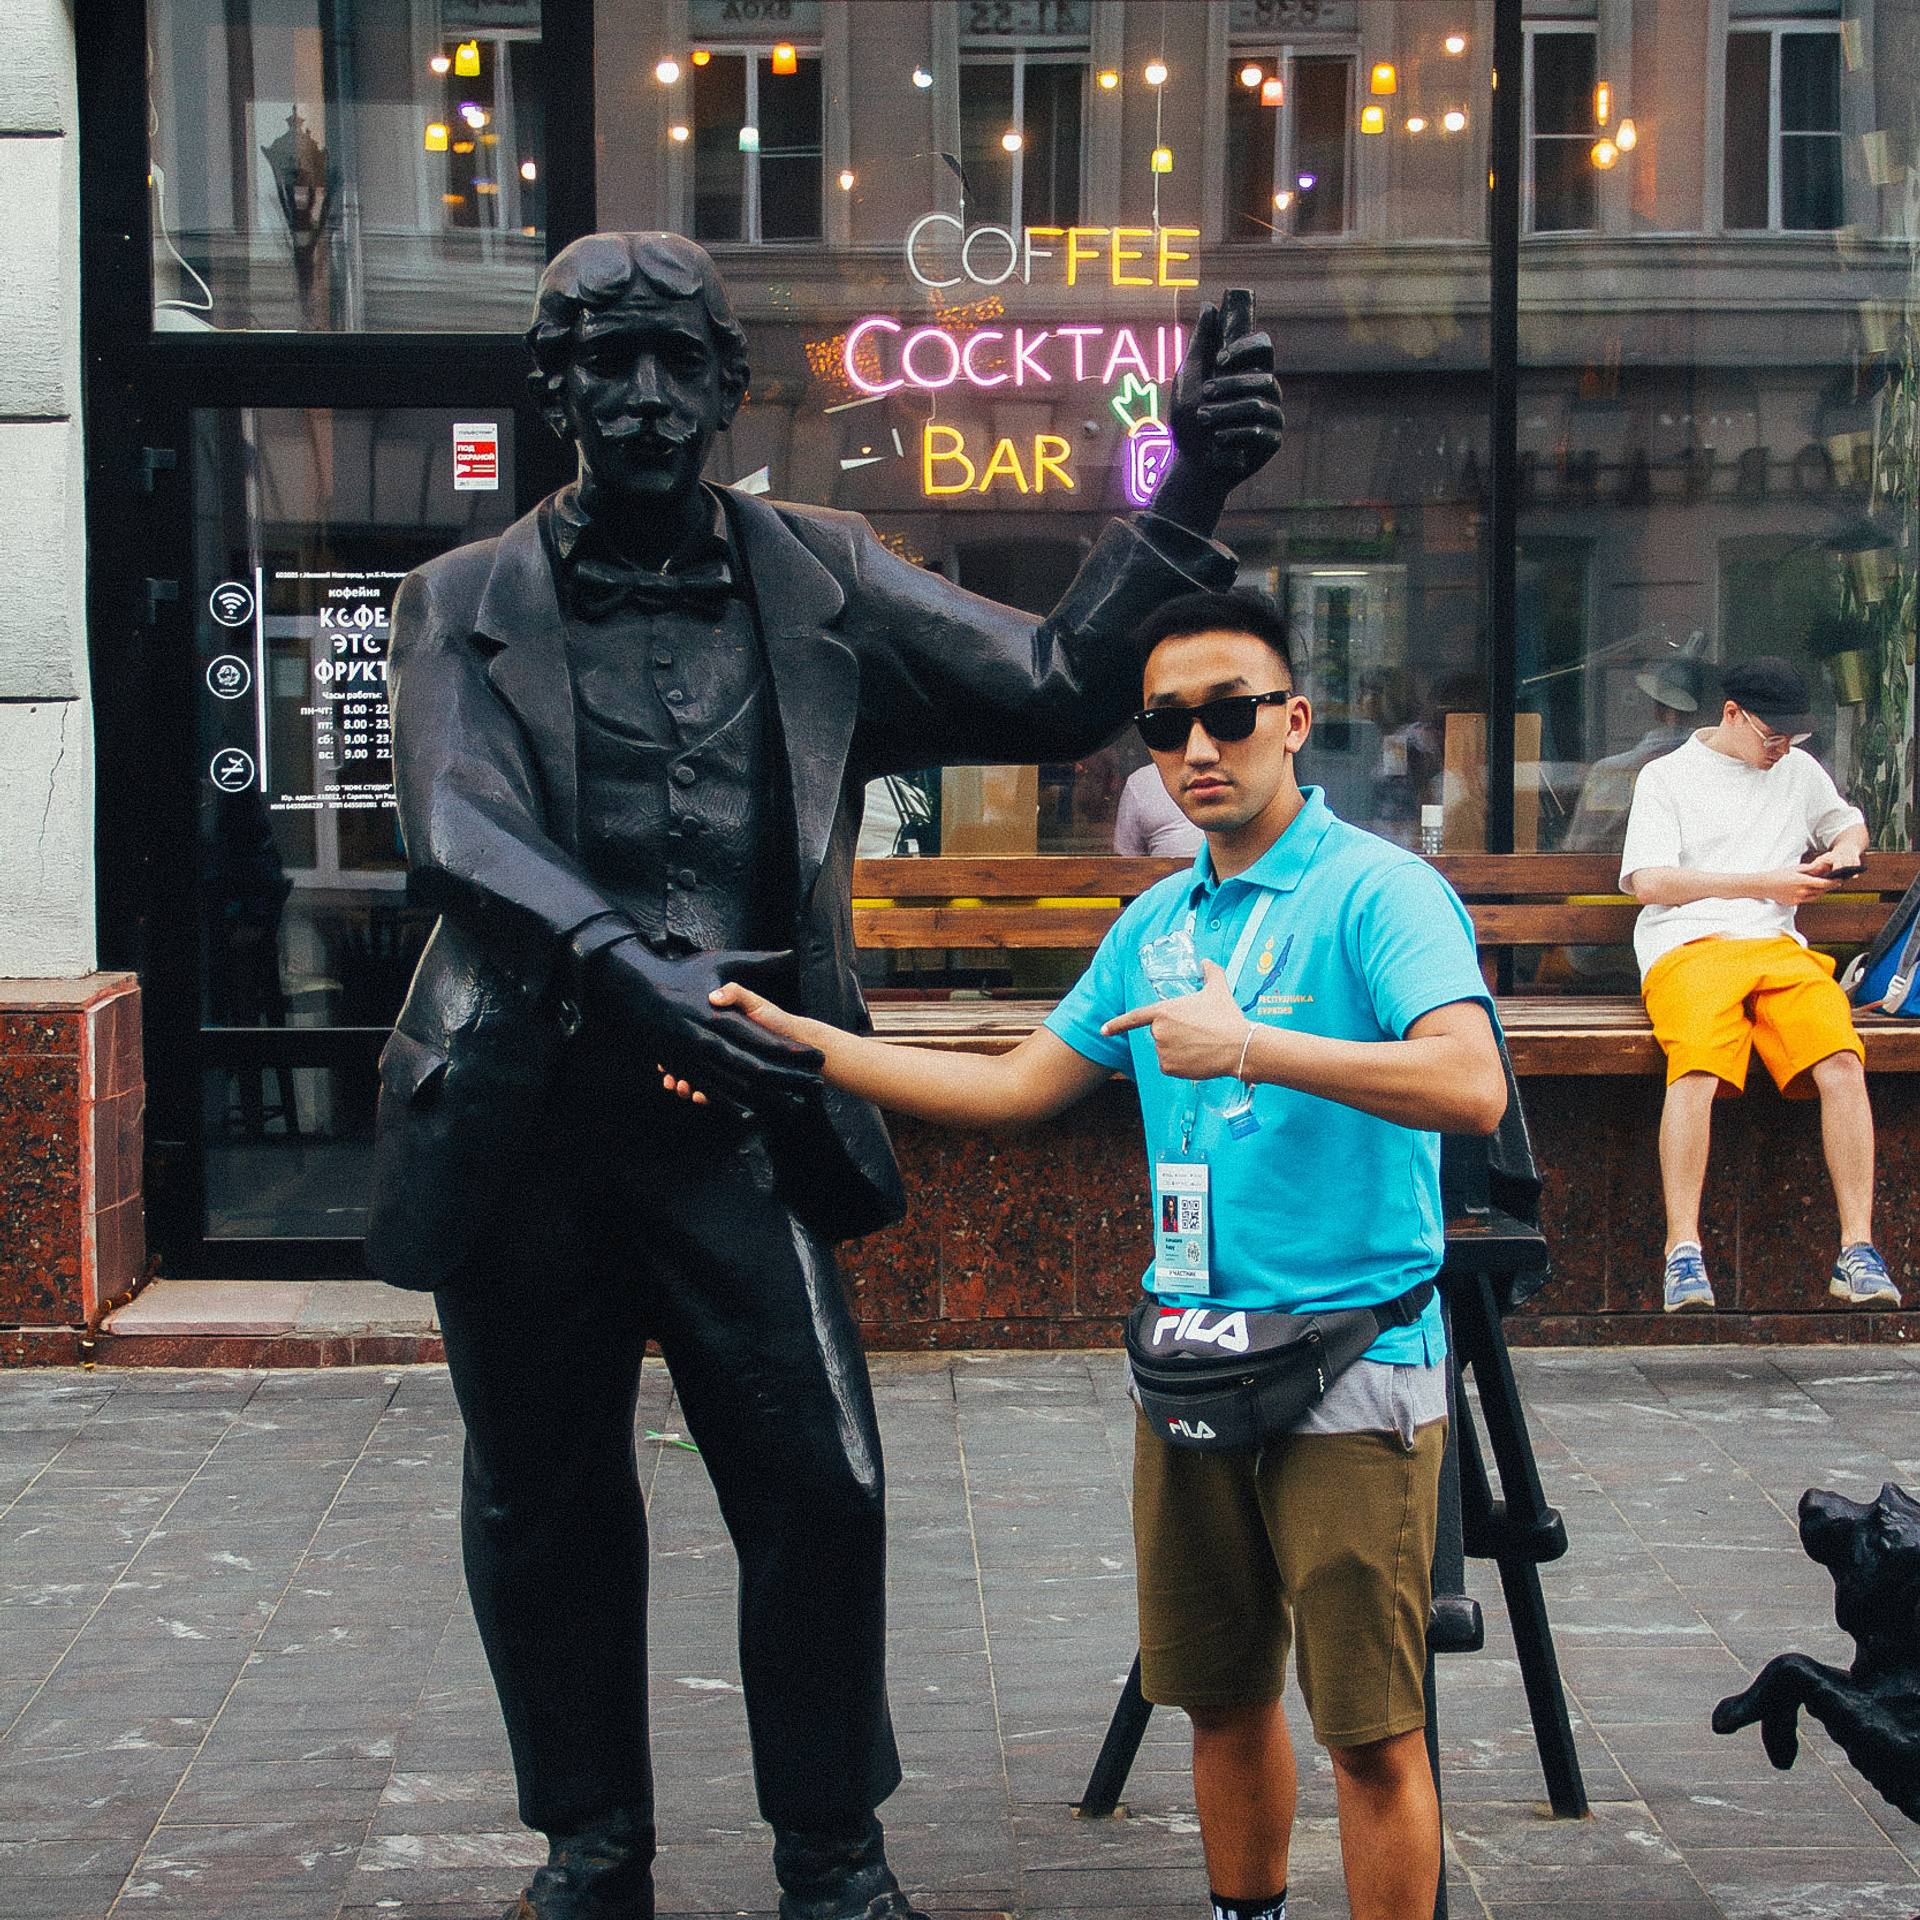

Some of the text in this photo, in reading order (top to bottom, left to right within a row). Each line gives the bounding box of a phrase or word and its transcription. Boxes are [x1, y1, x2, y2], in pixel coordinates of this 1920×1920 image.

[907, 214, 1200, 288] COFFEE
[923, 426, 1075, 495] BAR
[328, 586, 380, 600] кофейня
[321, 690, 383, 700] Часы работы:
[300, 706, 333, 716] пн-чт:
[343, 704, 368, 714] 8.00
[317, 721, 334, 730] пт:
[343, 719, 368, 730] 8.00
[317, 733, 334, 745] сб:
[344, 733, 368, 745] 9.00
[318, 750, 334, 760] вс:
[344, 748, 368, 759] 9.00
[324, 784, 341, 792] ООО
[1258, 995, 1314, 1004] РЕСПУБЛИКА
[1152, 1307, 1250, 1352] FILA
[1166, 1417, 1217, 1439] FILA
